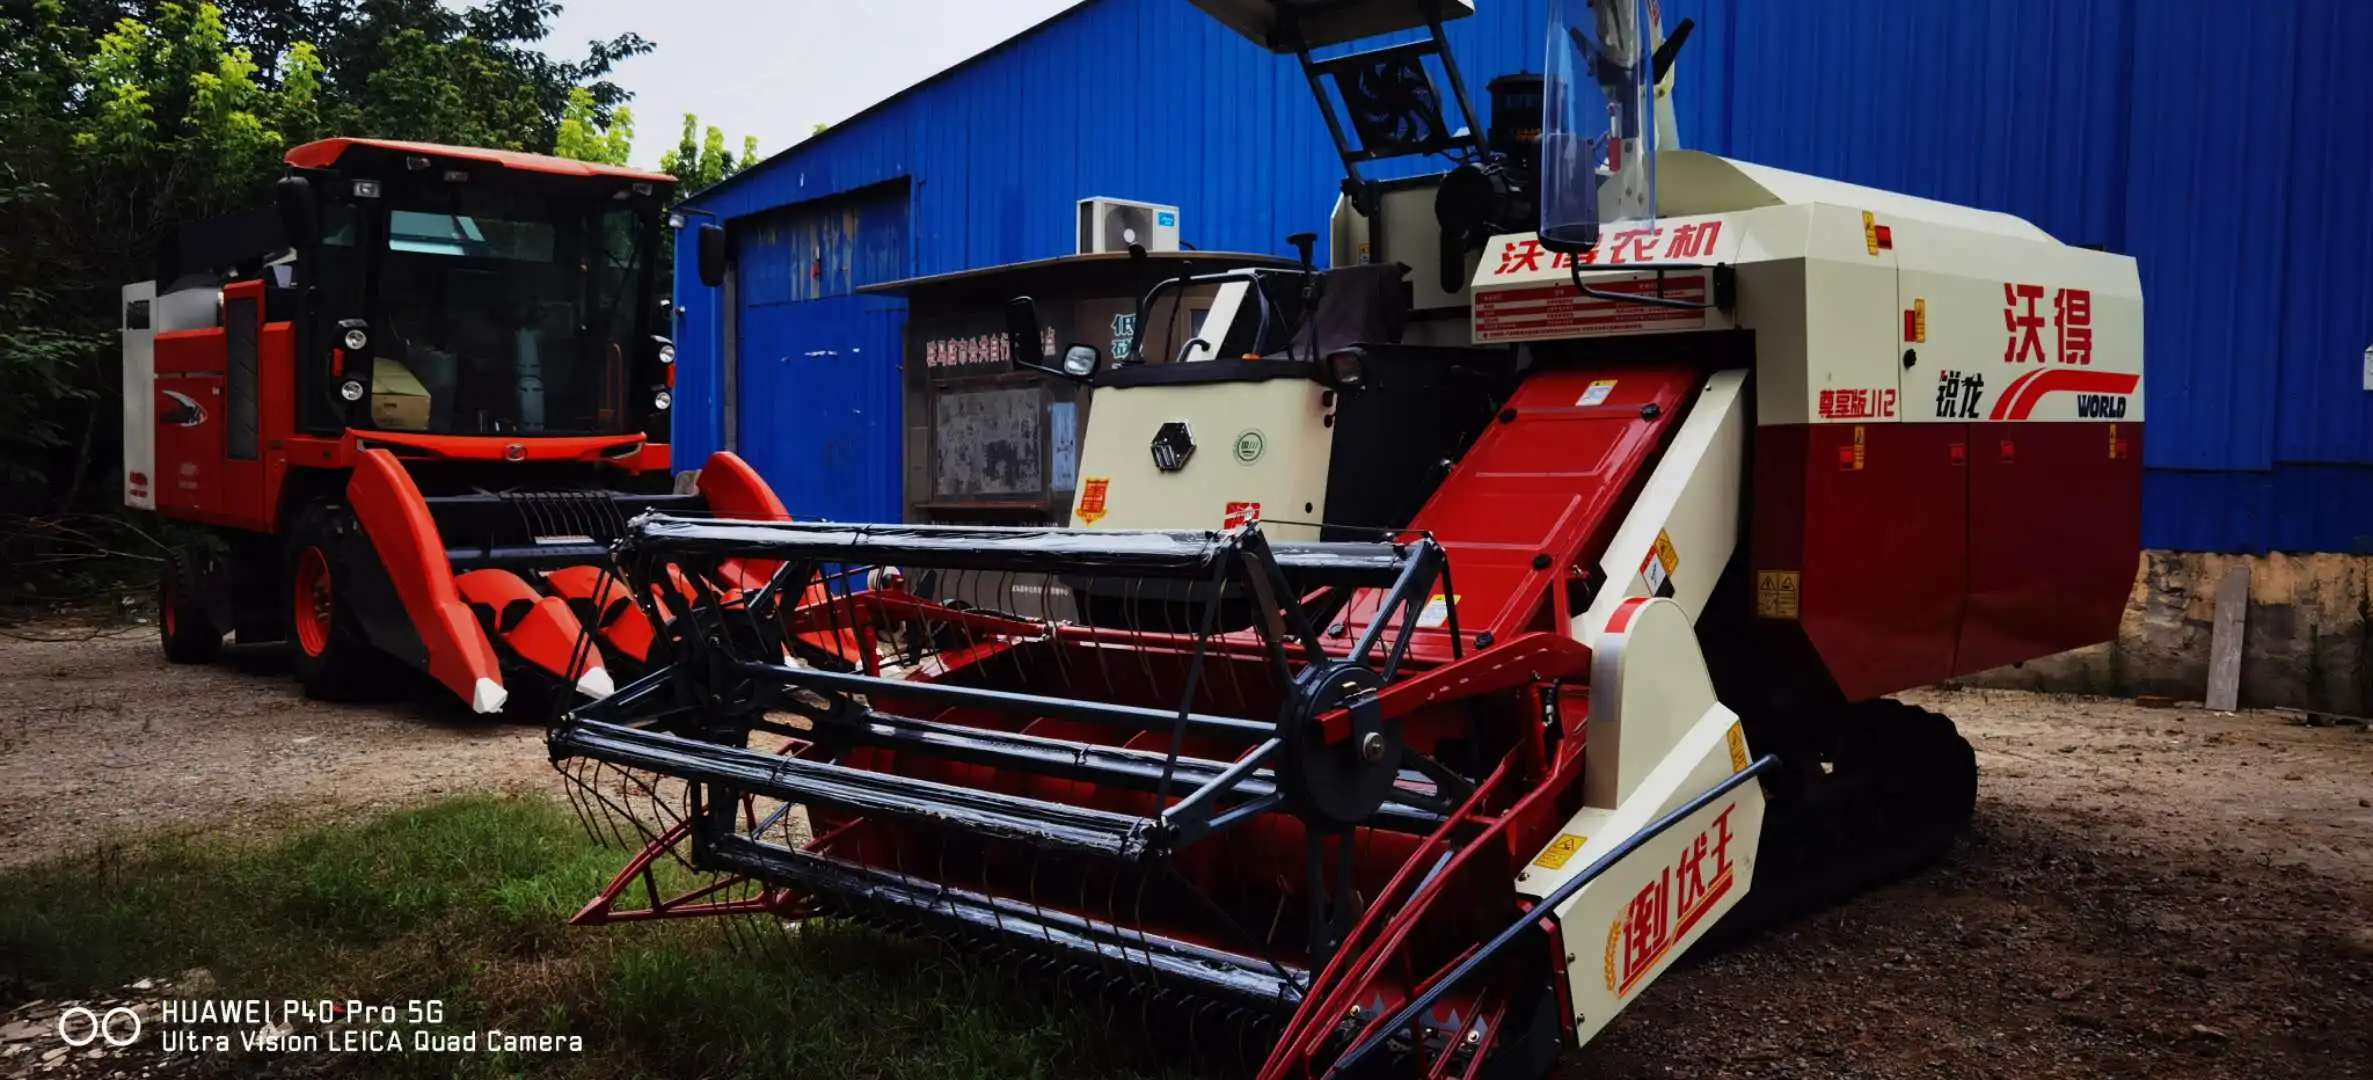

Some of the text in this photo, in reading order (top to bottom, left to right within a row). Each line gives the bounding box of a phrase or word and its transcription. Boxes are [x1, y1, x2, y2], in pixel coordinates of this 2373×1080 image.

[926, 325, 1056, 367] 驻马店市公共自行点
[2004, 282, 2092, 365] 沃得
[1936, 369, 1984, 418] 锐龙
[2077, 394, 2126, 418] WORLD
[1623, 801, 1736, 981] 倒伏王
